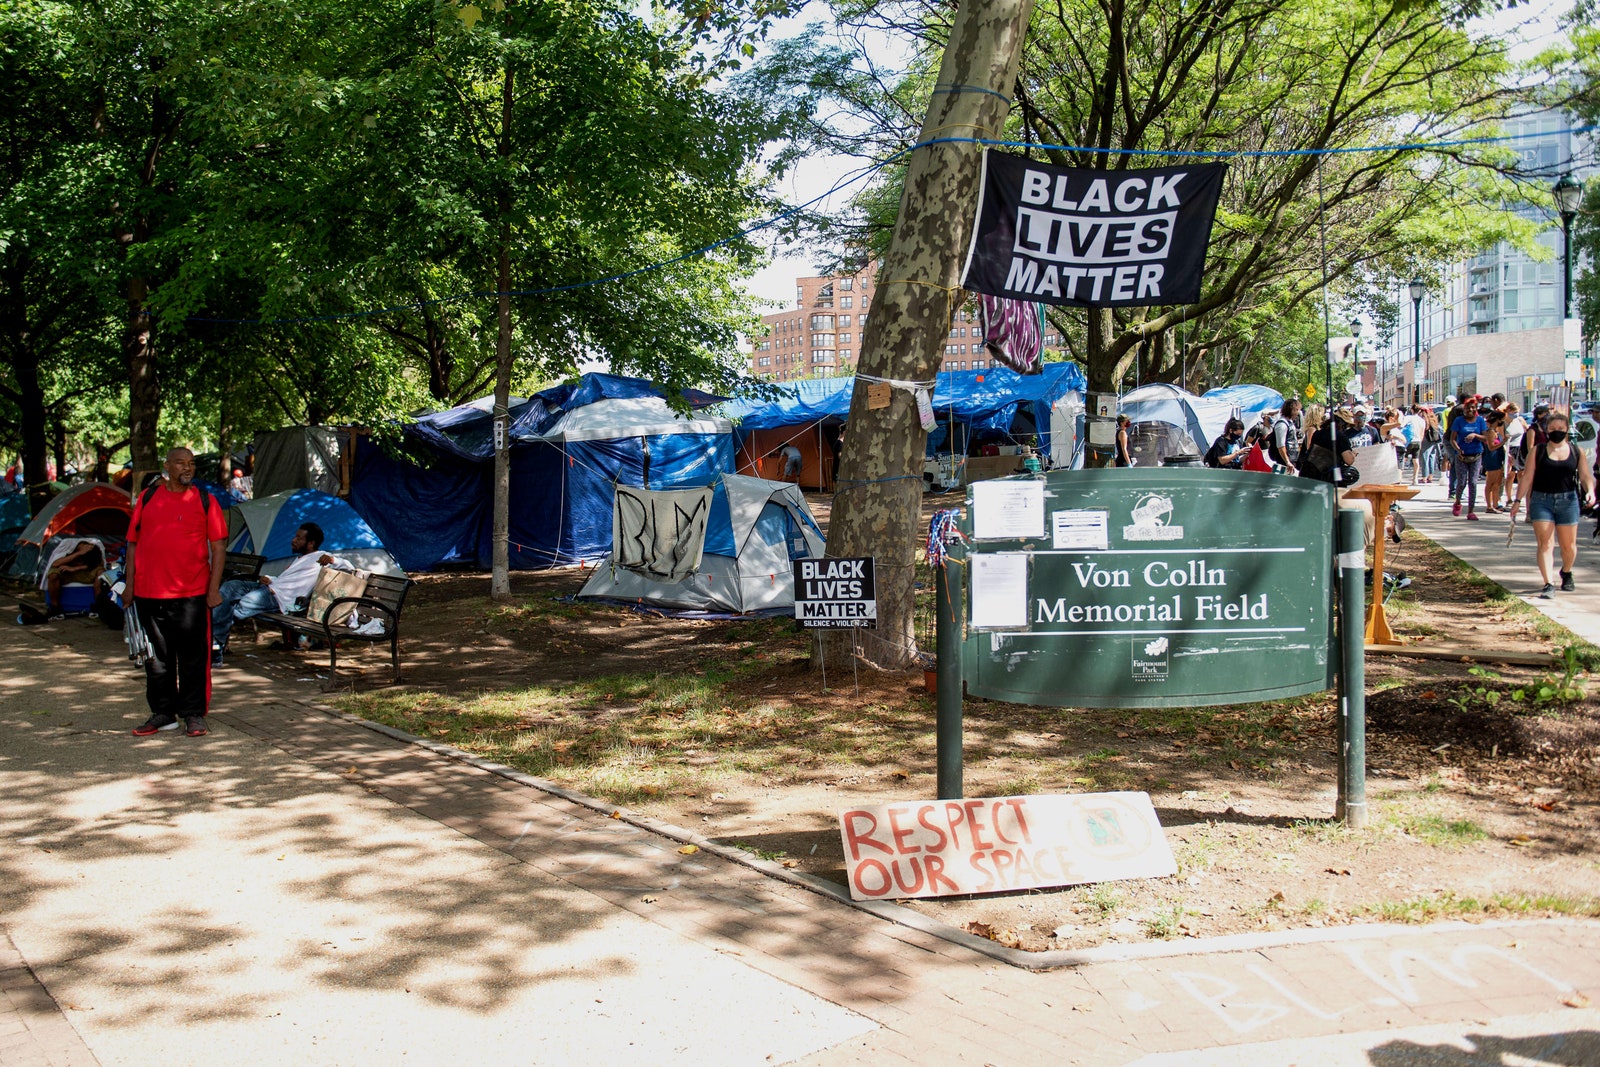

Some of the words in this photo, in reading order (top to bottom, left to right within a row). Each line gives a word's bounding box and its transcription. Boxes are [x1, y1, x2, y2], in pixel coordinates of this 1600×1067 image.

[1021, 169, 1188, 213] BLACK
[1018, 213, 1170, 258] LIVES
[1004, 257, 1165, 301] MATTER
[617, 490, 706, 579] BLM
[801, 560, 866, 579] BLACK
[806, 580, 862, 599] LIVES
[1071, 562, 1131, 588] Von
[1143, 560, 1227, 588] Colln
[803, 602, 867, 617] MATTER
[1035, 595, 1183, 623] Memorial
[1195, 594, 1269, 621] Field
[844, 799, 1032, 861] RESPECT
[853, 854, 960, 896] OUR
[969, 846, 1084, 892] SPACE
